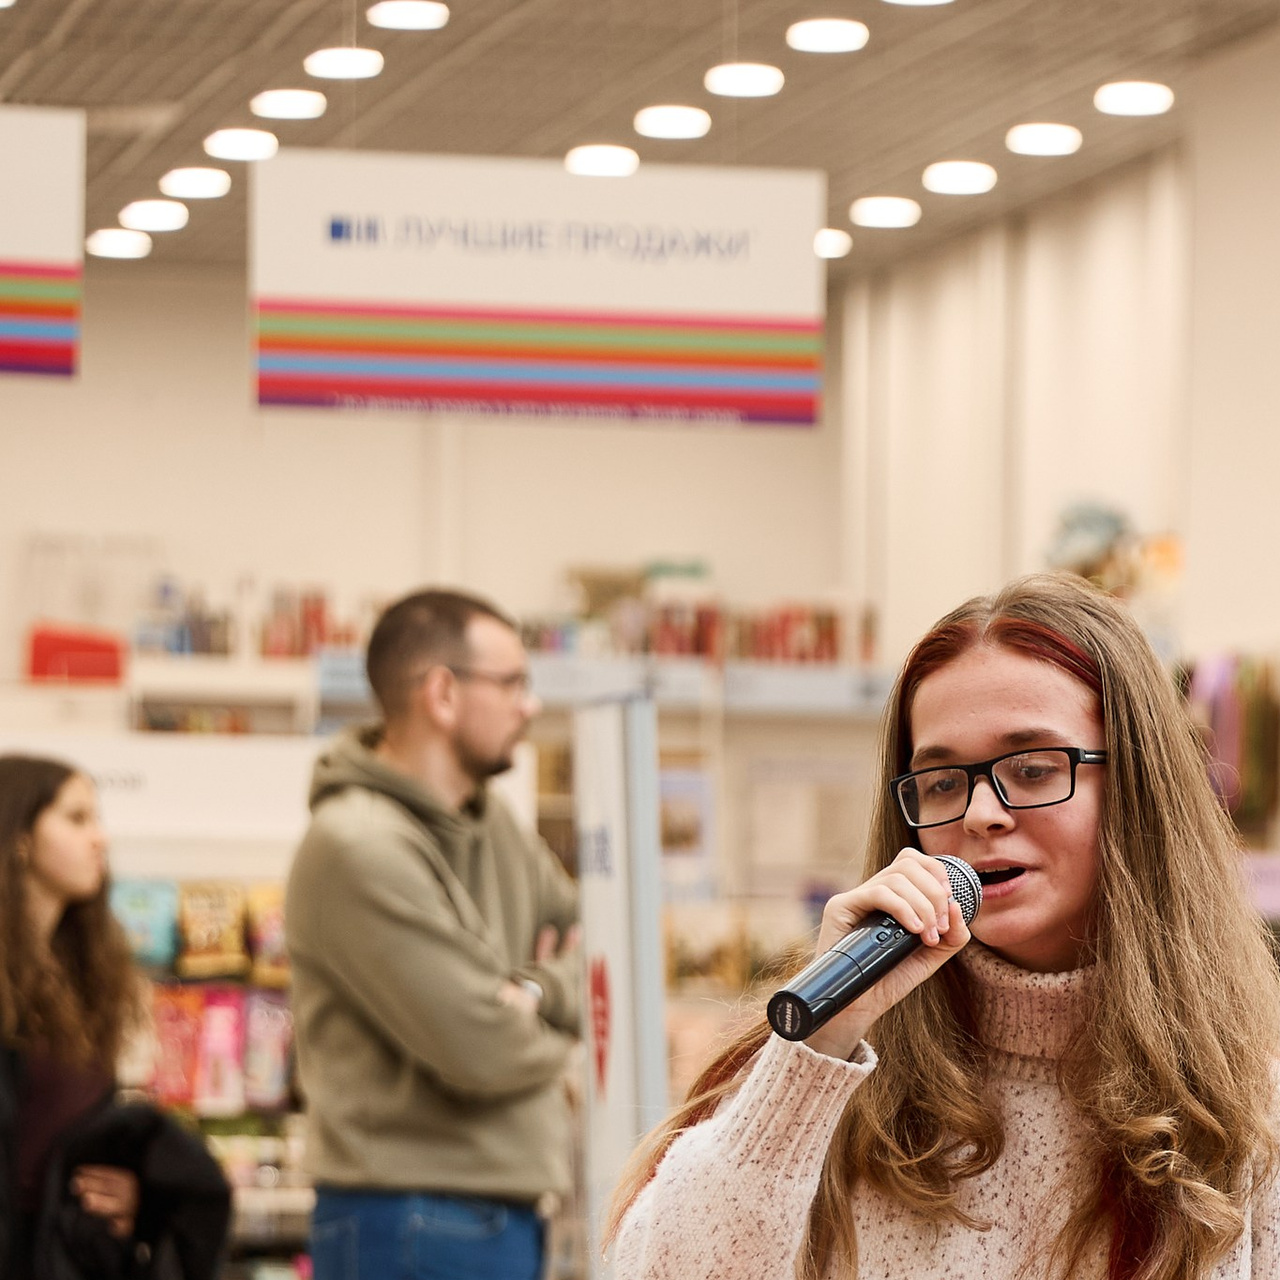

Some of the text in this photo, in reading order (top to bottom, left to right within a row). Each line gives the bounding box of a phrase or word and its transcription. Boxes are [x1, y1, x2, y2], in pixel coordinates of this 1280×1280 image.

[395, 214, 752, 264] ЛУЧШИЕ ПРОДАЖИ
[785, 1001, 793, 1034] SHURE
